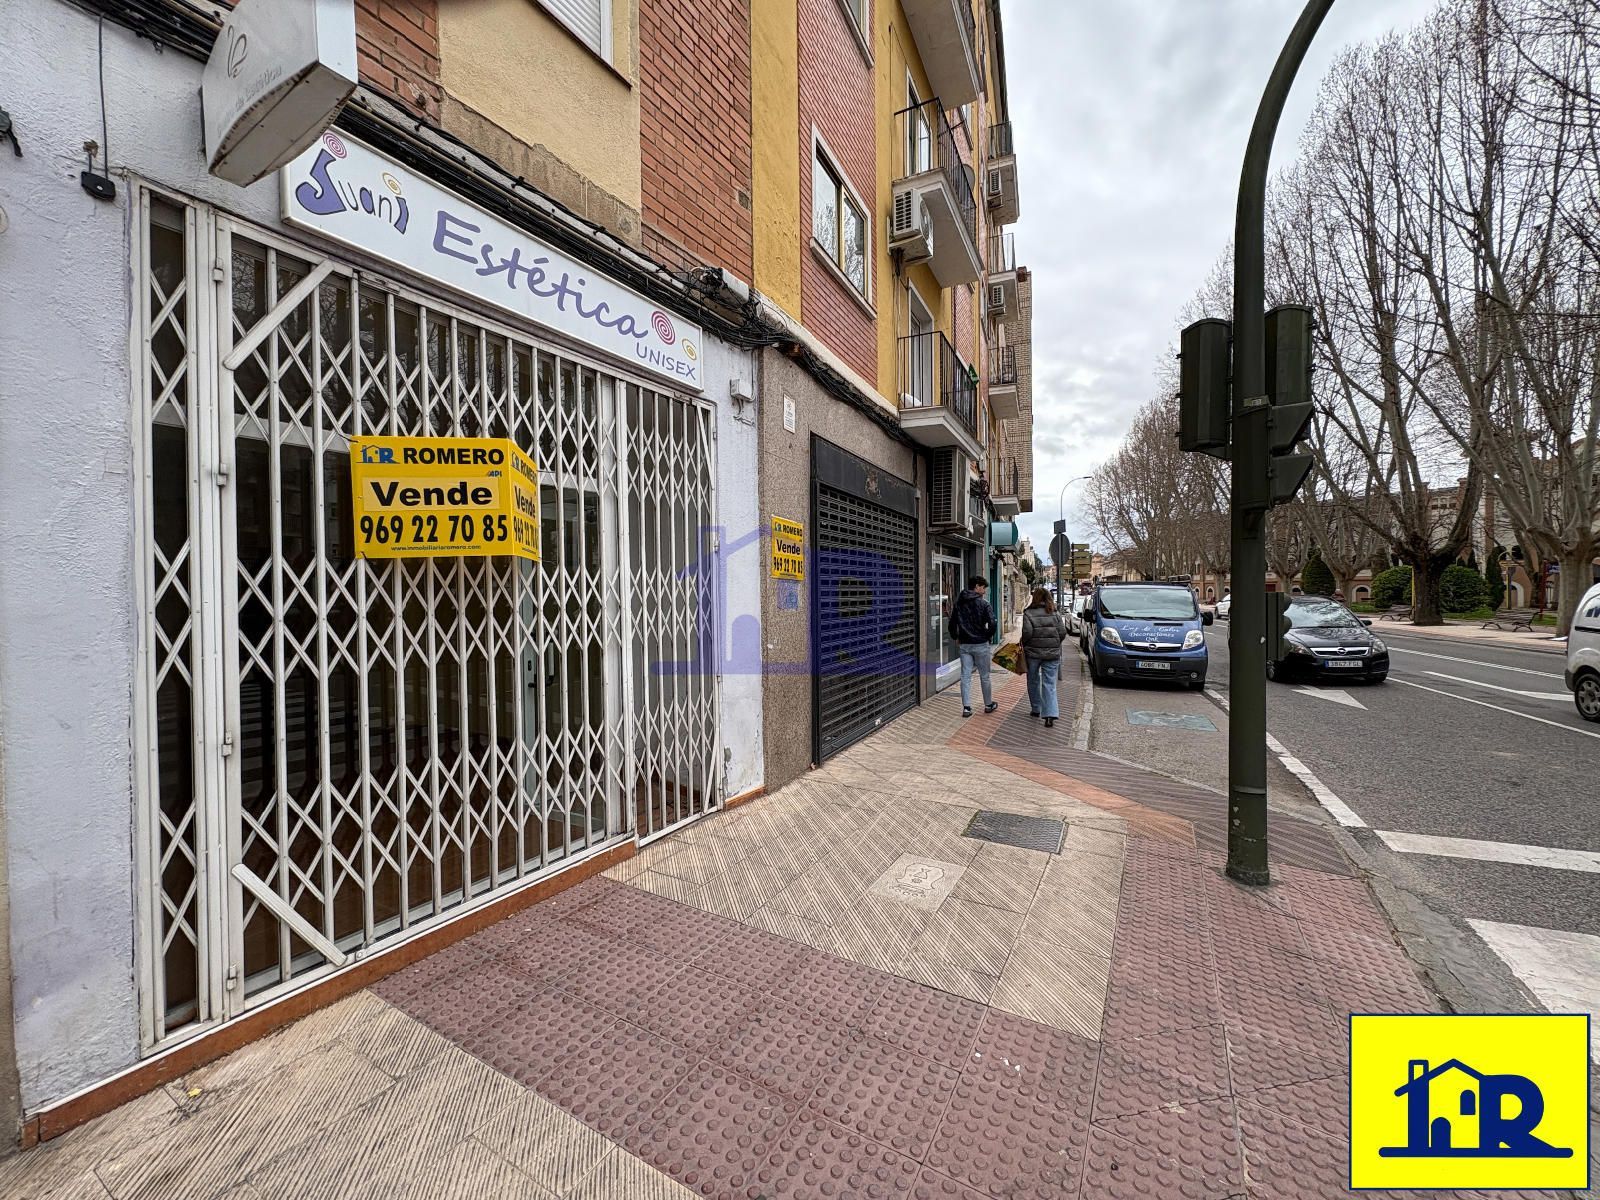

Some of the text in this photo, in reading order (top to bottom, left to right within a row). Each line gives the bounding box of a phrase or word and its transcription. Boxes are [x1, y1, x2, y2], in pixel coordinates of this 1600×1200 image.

[294, 134, 410, 235] Juani
[432, 210, 649, 339] Estética
[635, 341, 696, 381] UNISEX
[403, 447, 505, 465] ROMERO
[370, 481, 493, 507] Vende
[514, 485, 536, 519] Vende
[360, 515, 404, 544] 969
[411, 515, 439, 543] 22
[448, 515, 475, 542] 70
[482, 514, 508, 542] 85
[783, 525, 803, 537] ROMERO
[776, 539, 801, 555] Vende
